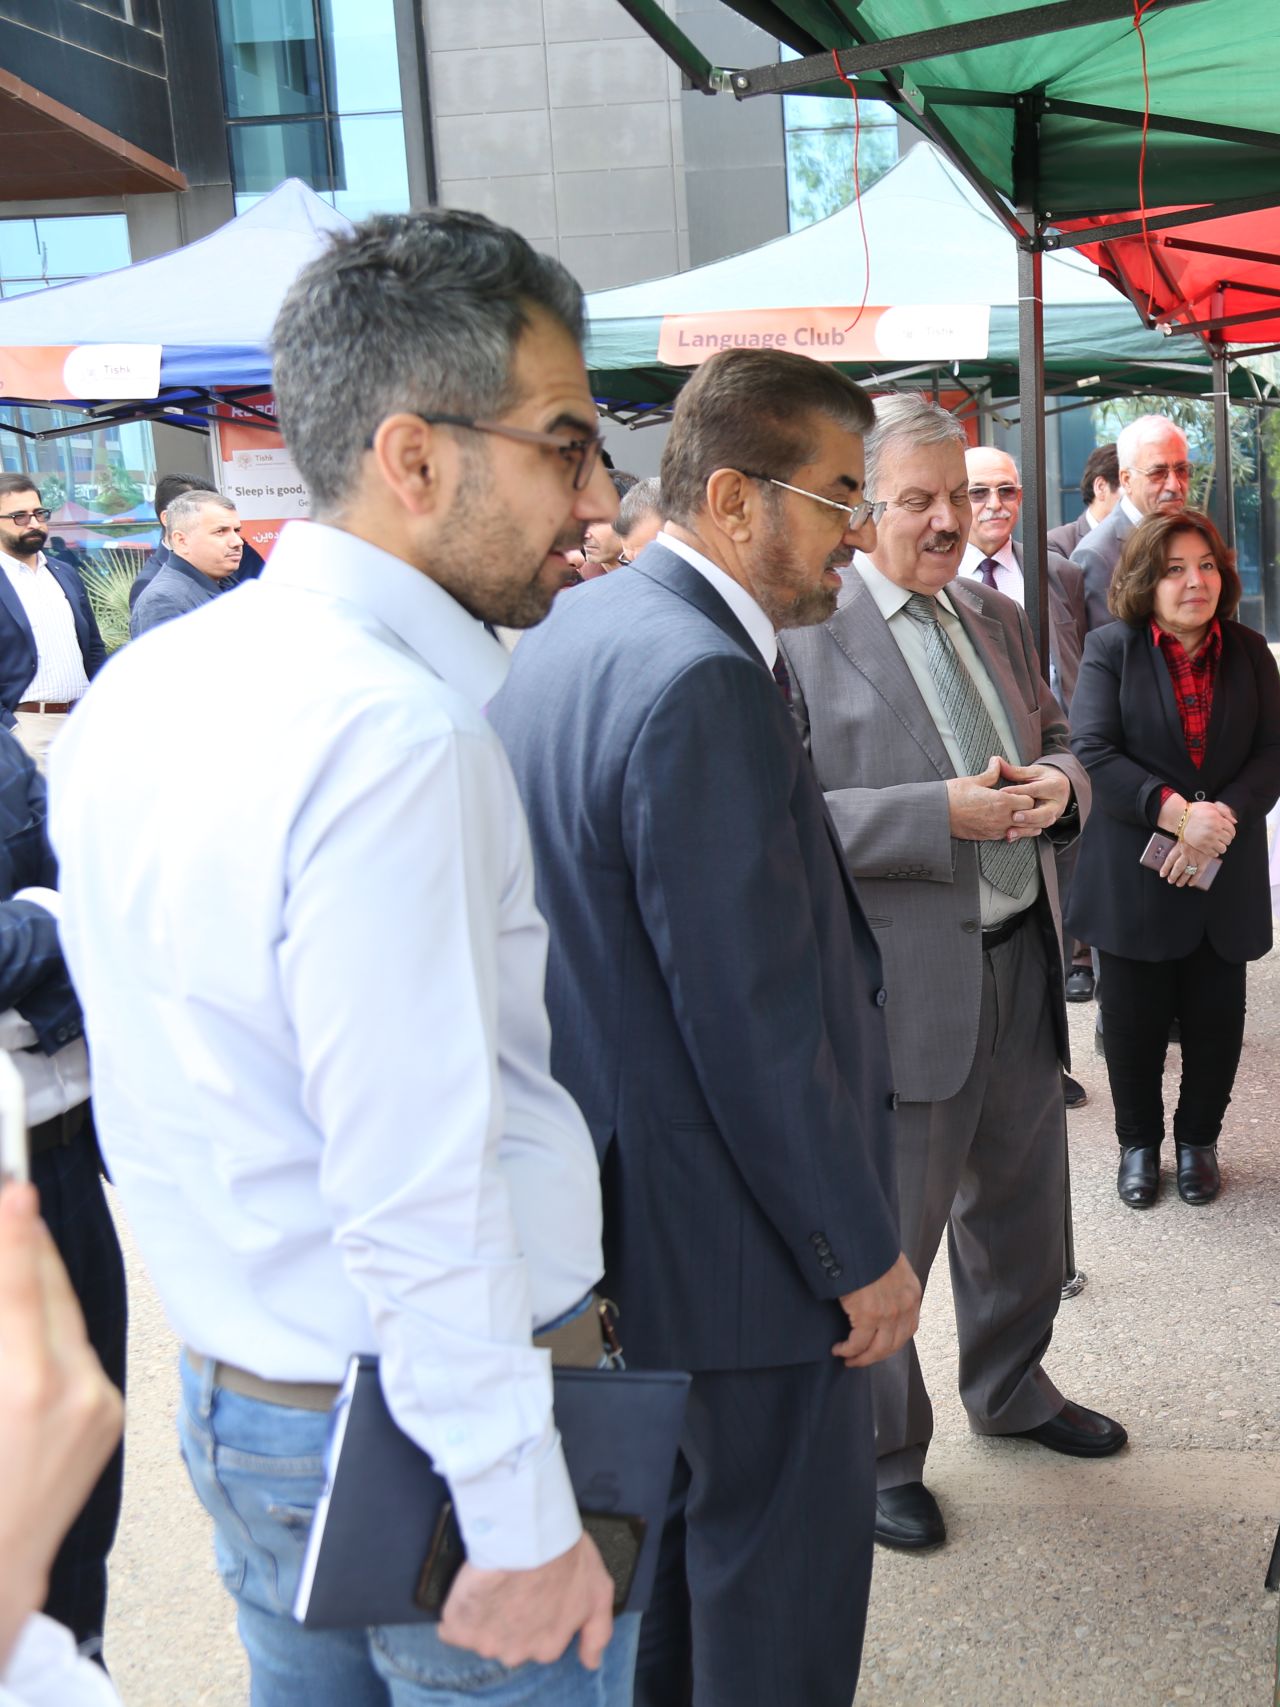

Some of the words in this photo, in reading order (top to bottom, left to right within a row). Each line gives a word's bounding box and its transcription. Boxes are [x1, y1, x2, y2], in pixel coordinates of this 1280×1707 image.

[678, 330, 787, 349] Language
[794, 327, 845, 346] Club
[103, 364, 132, 375] Tishk
[235, 486, 264, 497] Sleep
[266, 485, 275, 495] is
[277, 484, 306, 497] good,
